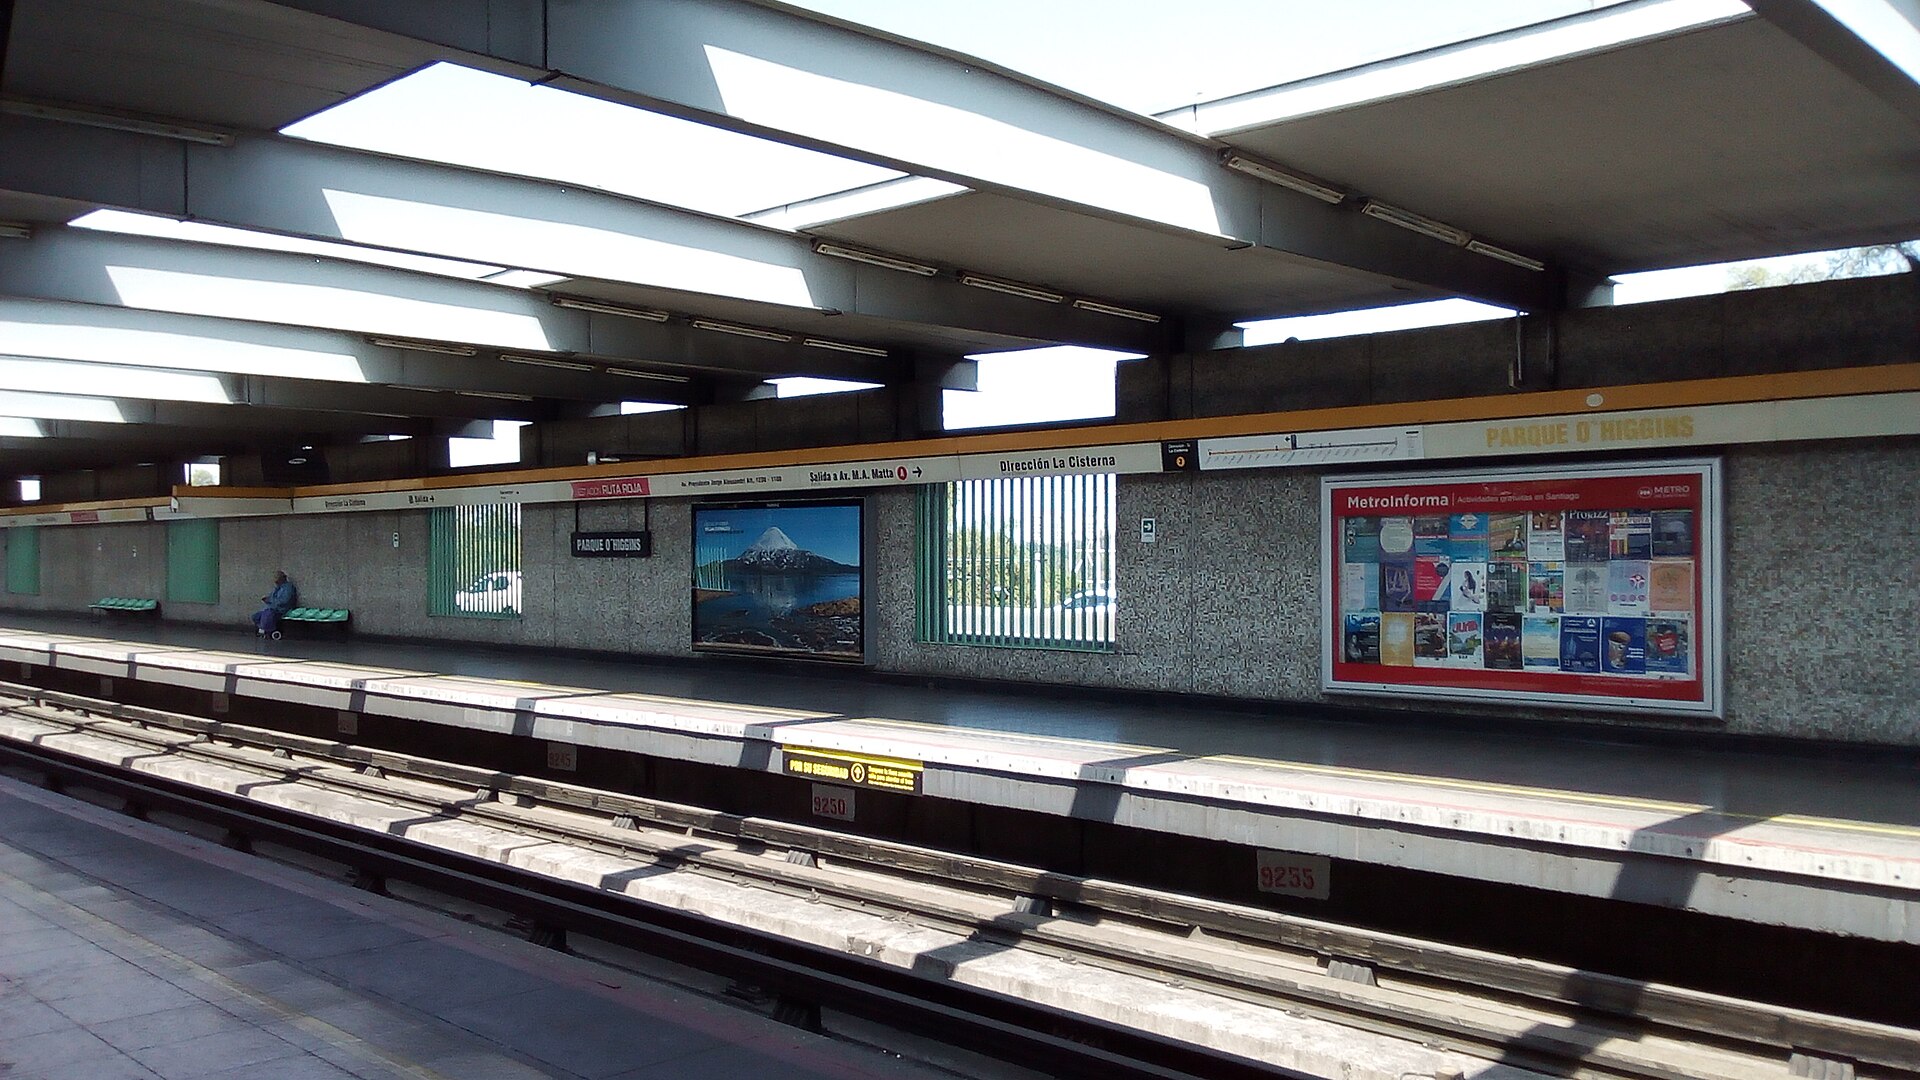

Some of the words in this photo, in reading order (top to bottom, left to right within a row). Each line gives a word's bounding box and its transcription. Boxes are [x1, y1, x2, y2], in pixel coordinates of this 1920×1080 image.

[1486, 422, 1568, 448] PARQUE
[1053, 457, 1066, 469] La
[1068, 456, 1115, 468] Cisterna
[809, 471, 832, 483] Salida
[833, 473, 838, 481] a
[852, 469, 870, 480] M.A.
[872, 468, 894, 479] Matta
[602, 484, 621, 494] RUTA
[622, 483, 642, 493] ROJA
[1653, 485, 1690, 493] METRO
[1347, 494, 1449, 509] MetroInforma
[1545, 493, 1579, 502] Santiago
[576, 538, 604, 552] PARQUE
[814, 796, 846, 815] 9250
[1261, 866, 1315, 890] 9255
